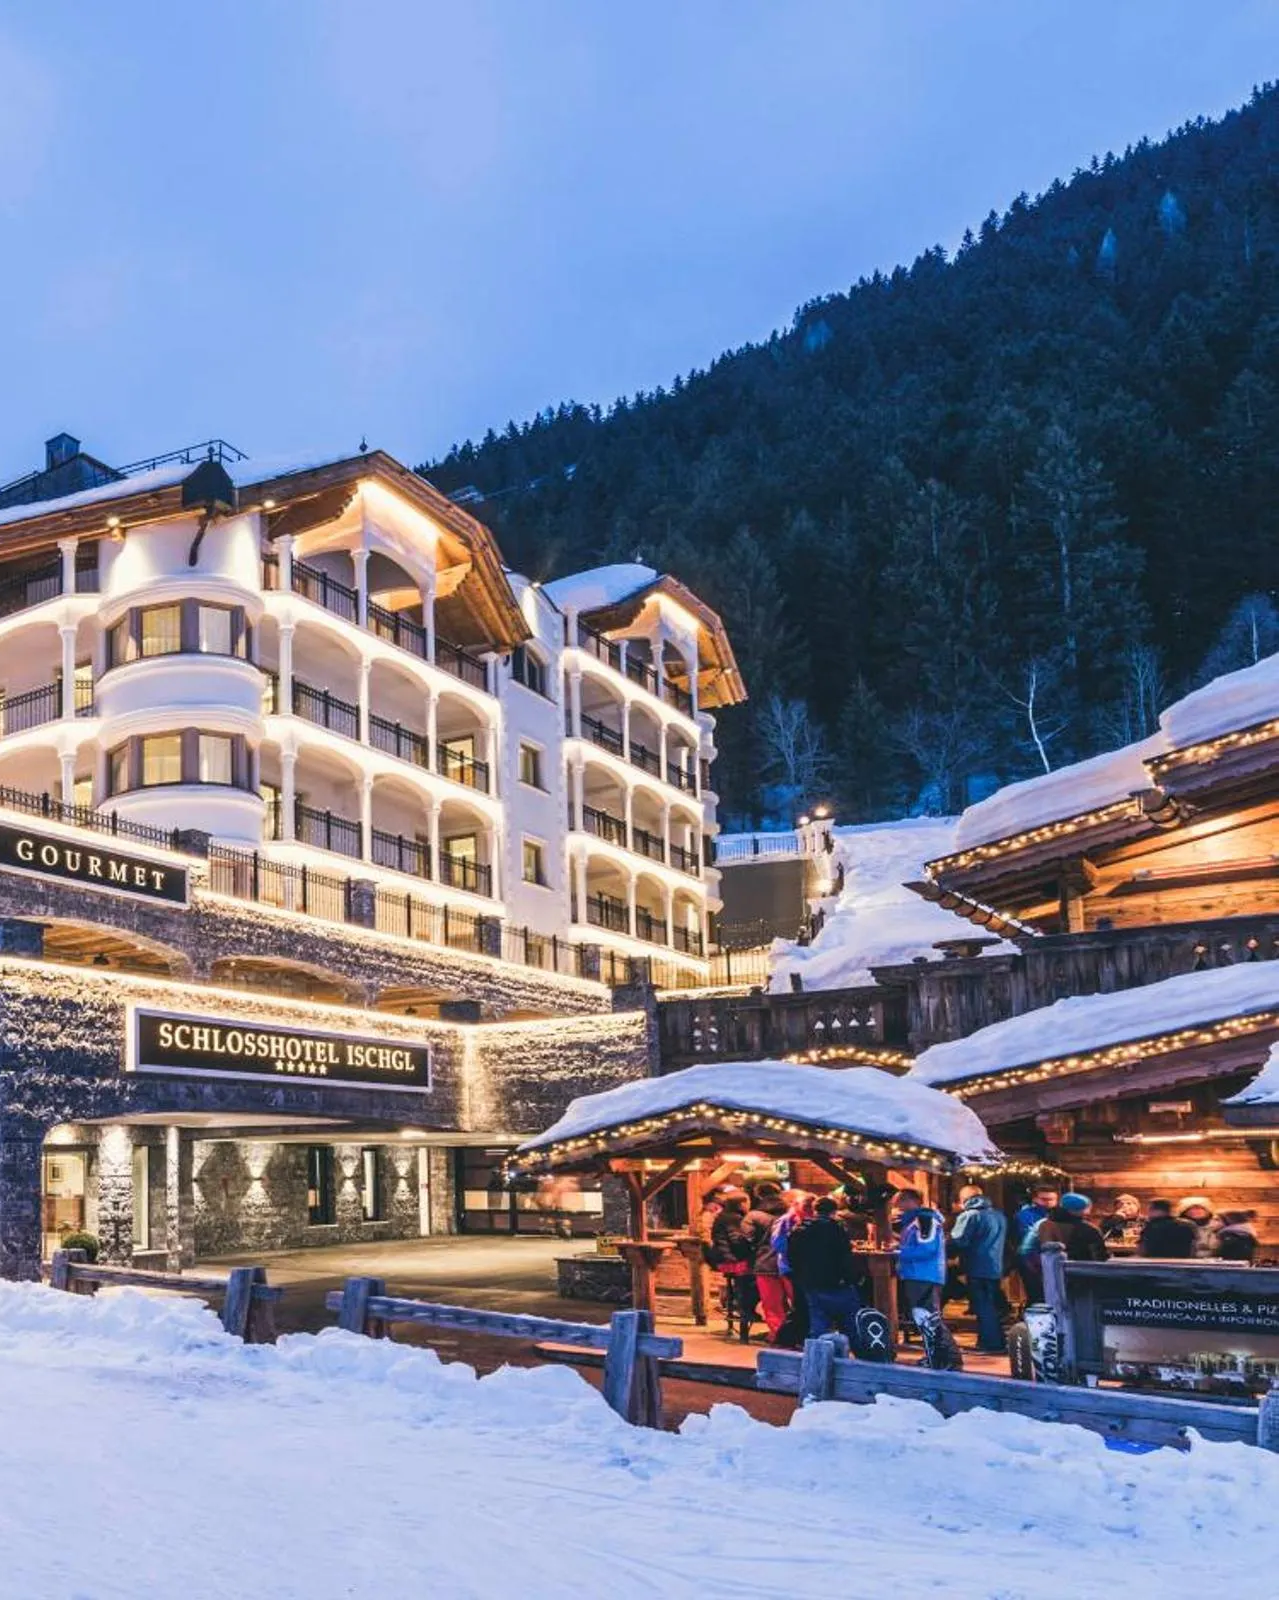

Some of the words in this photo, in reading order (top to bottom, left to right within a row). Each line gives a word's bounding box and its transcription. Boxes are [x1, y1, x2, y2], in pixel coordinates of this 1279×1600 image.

[17, 839, 165, 891] GOURMET
[159, 1023, 339, 1064] SCHLOSSHOTEL
[347, 1045, 415, 1071] ISCHGL
[1126, 1298, 1237, 1314] TRADITIONELLES
[1242, 1304, 1253, 1314] &
